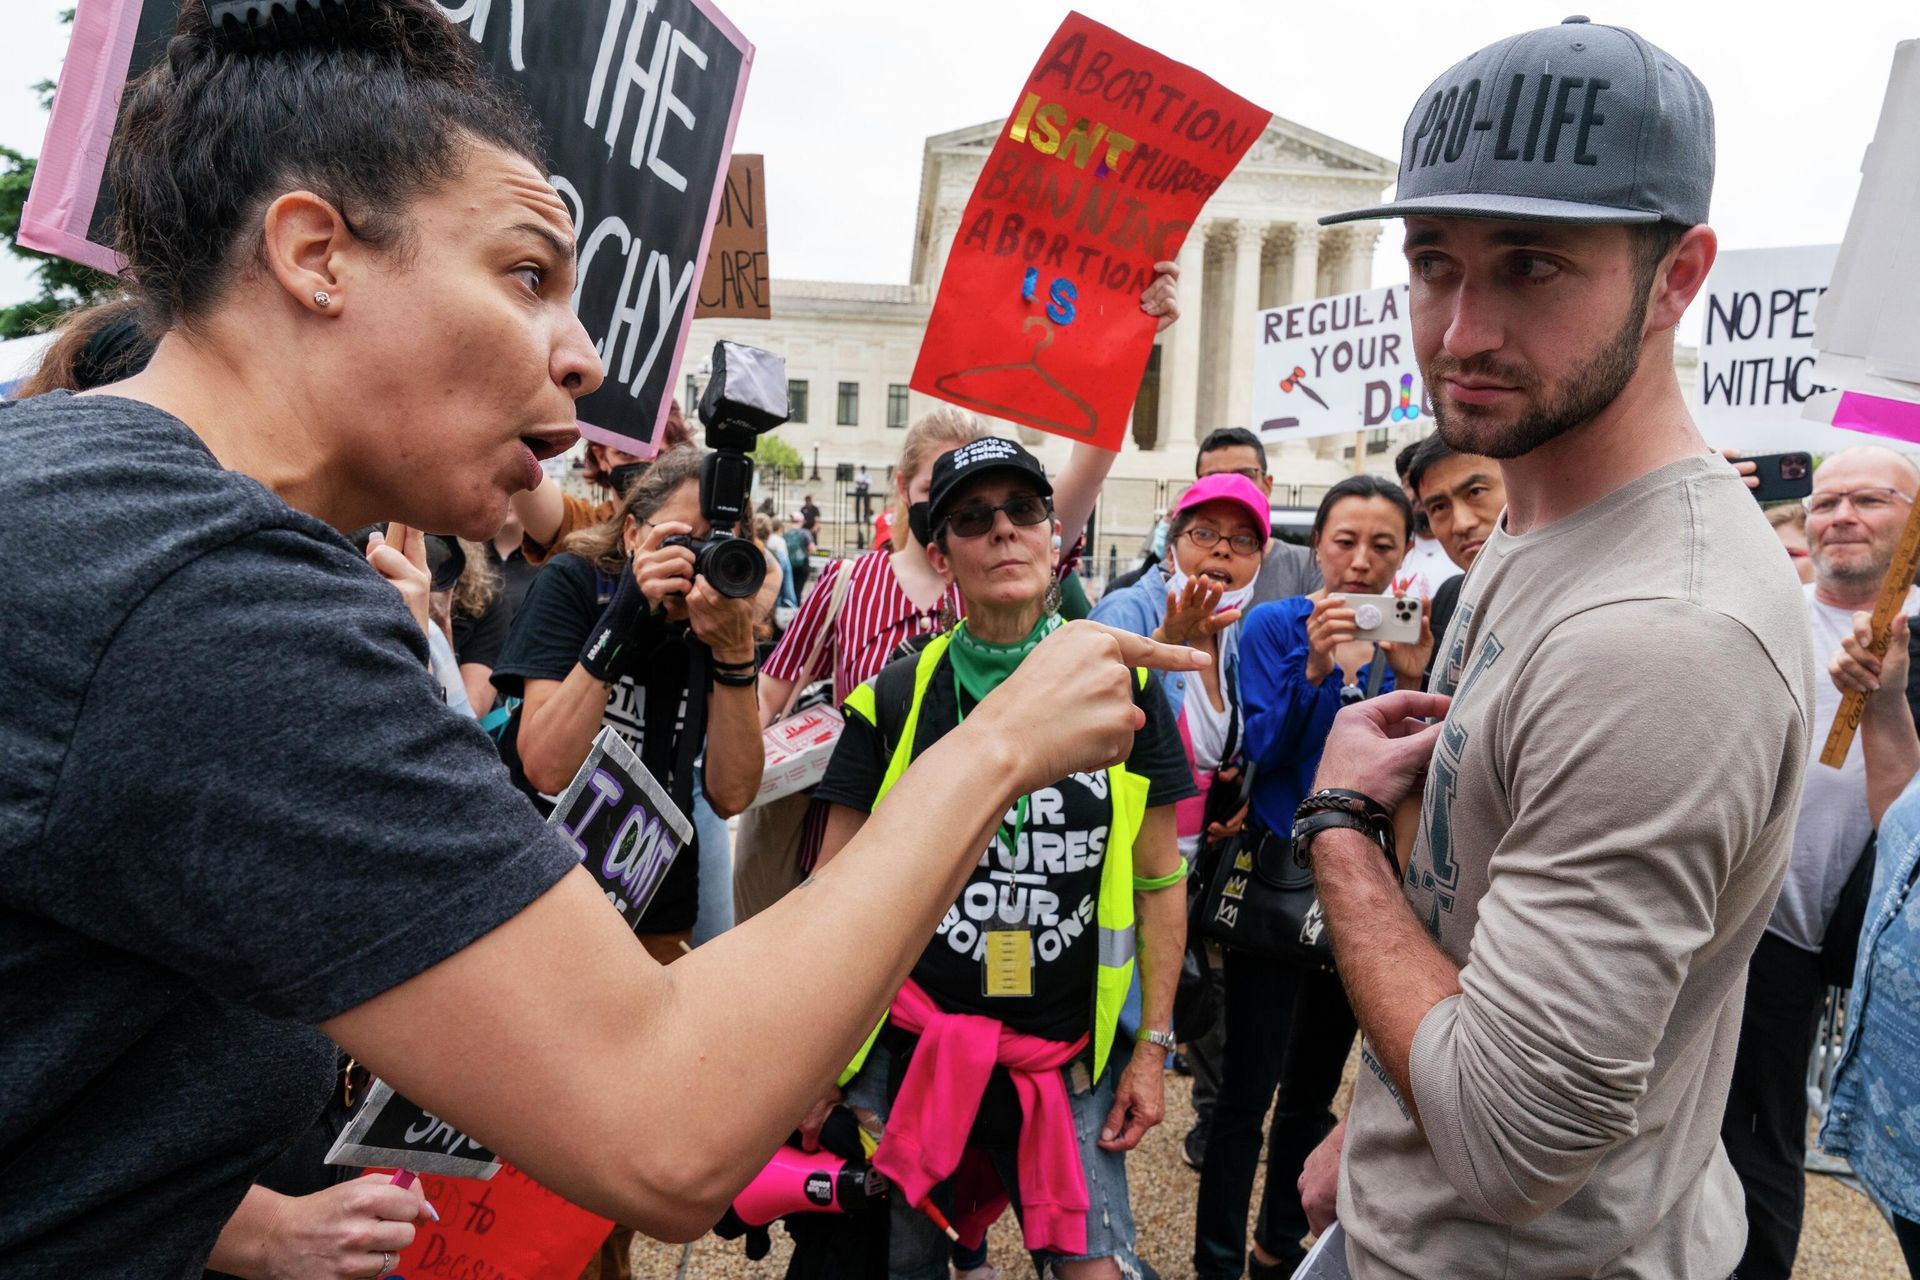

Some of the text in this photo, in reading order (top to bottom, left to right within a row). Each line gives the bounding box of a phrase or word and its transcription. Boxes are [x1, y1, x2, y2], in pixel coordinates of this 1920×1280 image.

[584, 0, 708, 192] THE
[1034, 31, 1249, 155] ABORTION
[1408, 73, 1611, 172] PRO-LIFE
[1119, 143, 1222, 200] MURDER
[980, 152, 1192, 262] BANNING
[963, 208, 1160, 297] ABORTION
[548, 175, 694, 398] CHY
[1021, 265, 1078, 327] IS
[1263, 285, 1410, 345] REGULA
[1706, 287, 1828, 345] NO PE
[1311, 334, 1401, 378] YOUR
[1703, 356, 1838, 406] WITHO
[970, 444, 1018, 455] cuidado
[963, 881, 1060, 927] OUR
